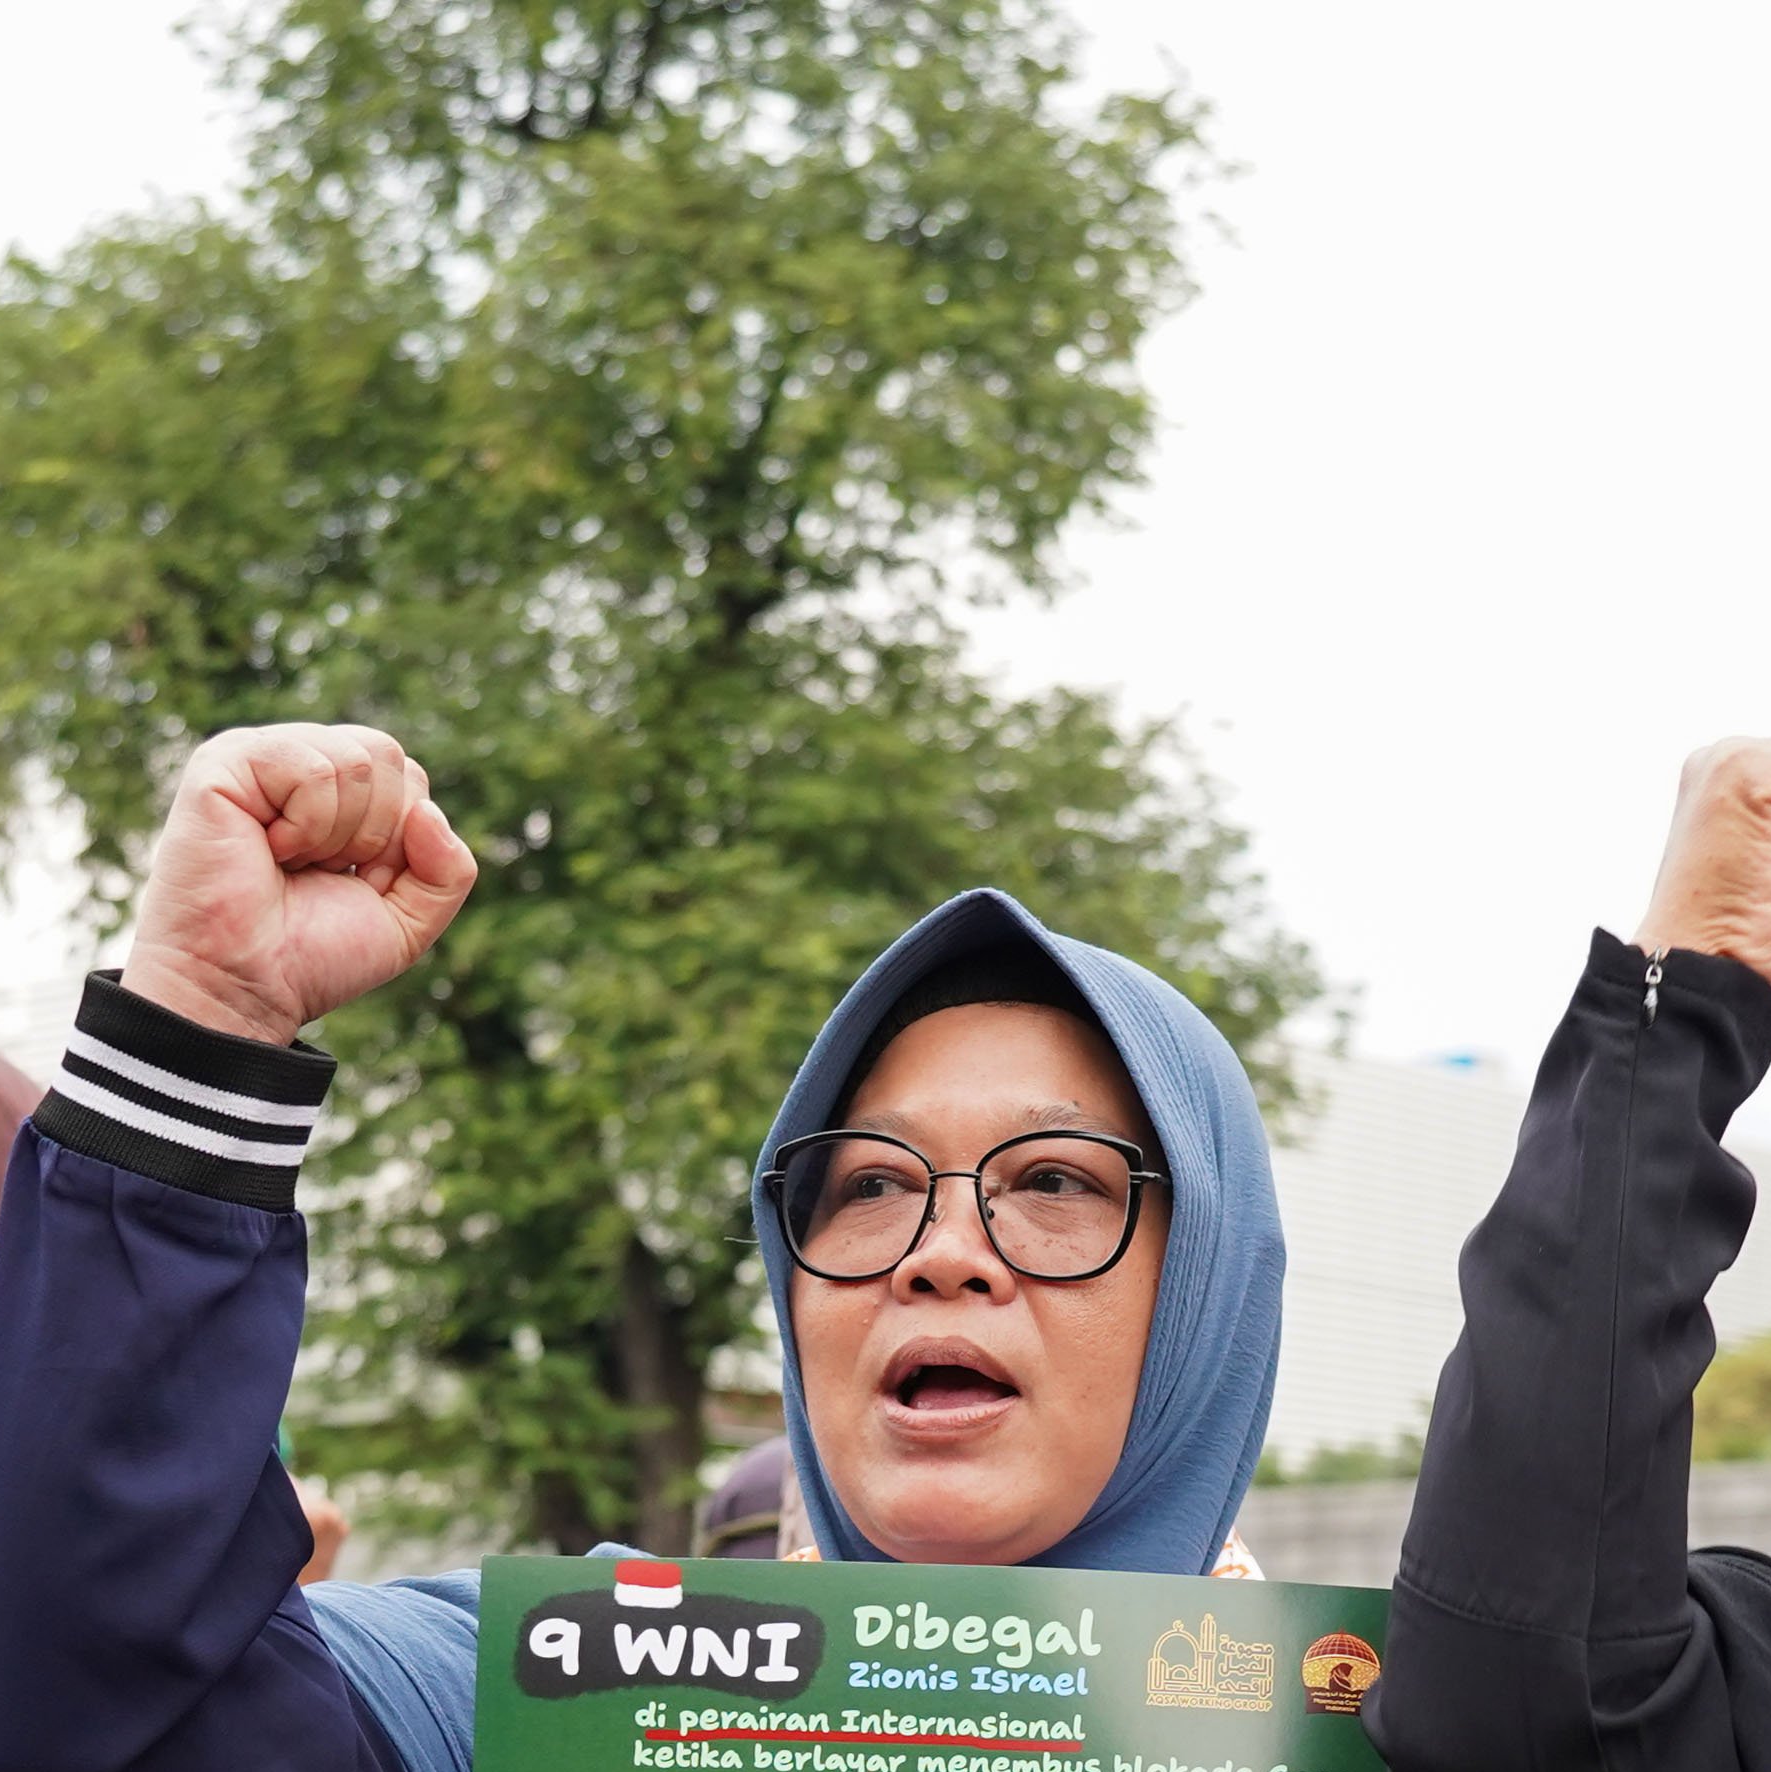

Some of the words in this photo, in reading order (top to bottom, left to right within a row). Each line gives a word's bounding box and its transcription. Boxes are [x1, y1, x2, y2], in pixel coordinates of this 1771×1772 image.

[529, 1617, 582, 1676] 9
[613, 1621, 802, 1683] WNI
[852, 1602, 1102, 1669] Dibegal
[848, 1661, 959, 1691] Zionis
[970, 1665, 1088, 1696] Israel
[634, 1701, 667, 1729] di
[679, 1706, 831, 1736] perairan
[840, 1708, 1086, 1742] Internasional
[1146, 1695, 1180, 1707] AQSA
[1180, 1697, 1232, 1710] WORKING
[1234, 1699, 1273, 1712] GROUP
[633, 1740, 743, 1772] ketika
